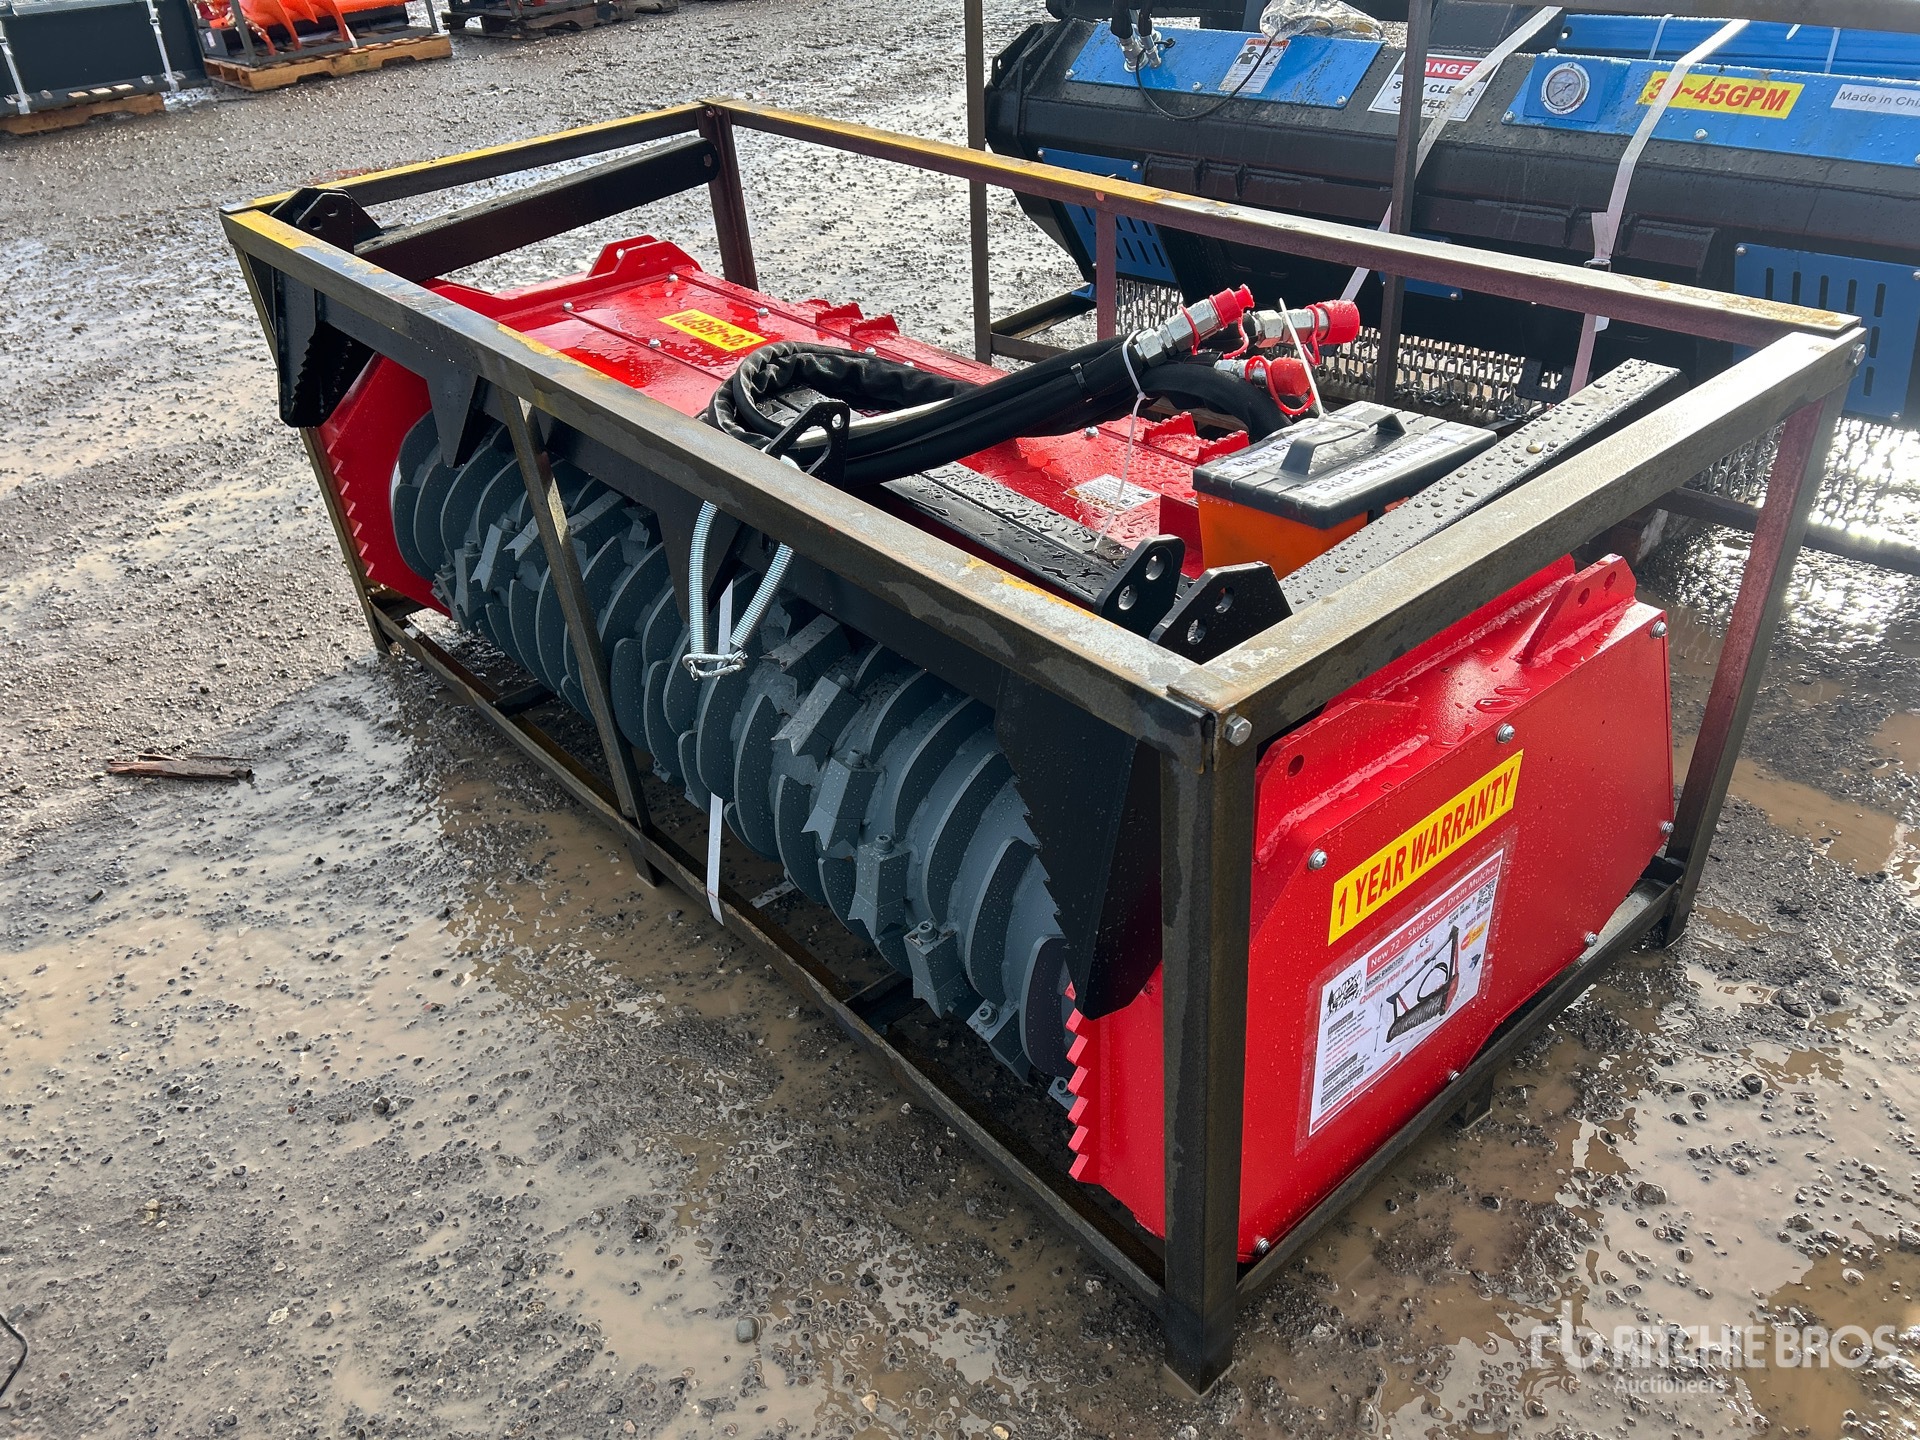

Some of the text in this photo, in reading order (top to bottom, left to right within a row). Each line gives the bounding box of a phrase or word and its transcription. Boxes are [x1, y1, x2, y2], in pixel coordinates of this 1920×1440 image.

[1424, 62, 1473, 76] ANGE
[1839, 91, 1920, 107] Made in Chi
[1316, 435, 1448, 493] Skid-Steer Mulcher
[1338, 766, 1515, 927] 1 YEAR WARRANTY
[1370, 950, 1389, 968] New
[1407, 903, 1447, 938] Skid-Steer
[1359, 980, 1387, 1005] Quality
[1387, 970, 1401, 986] you
[1401, 959, 1414, 973] can
